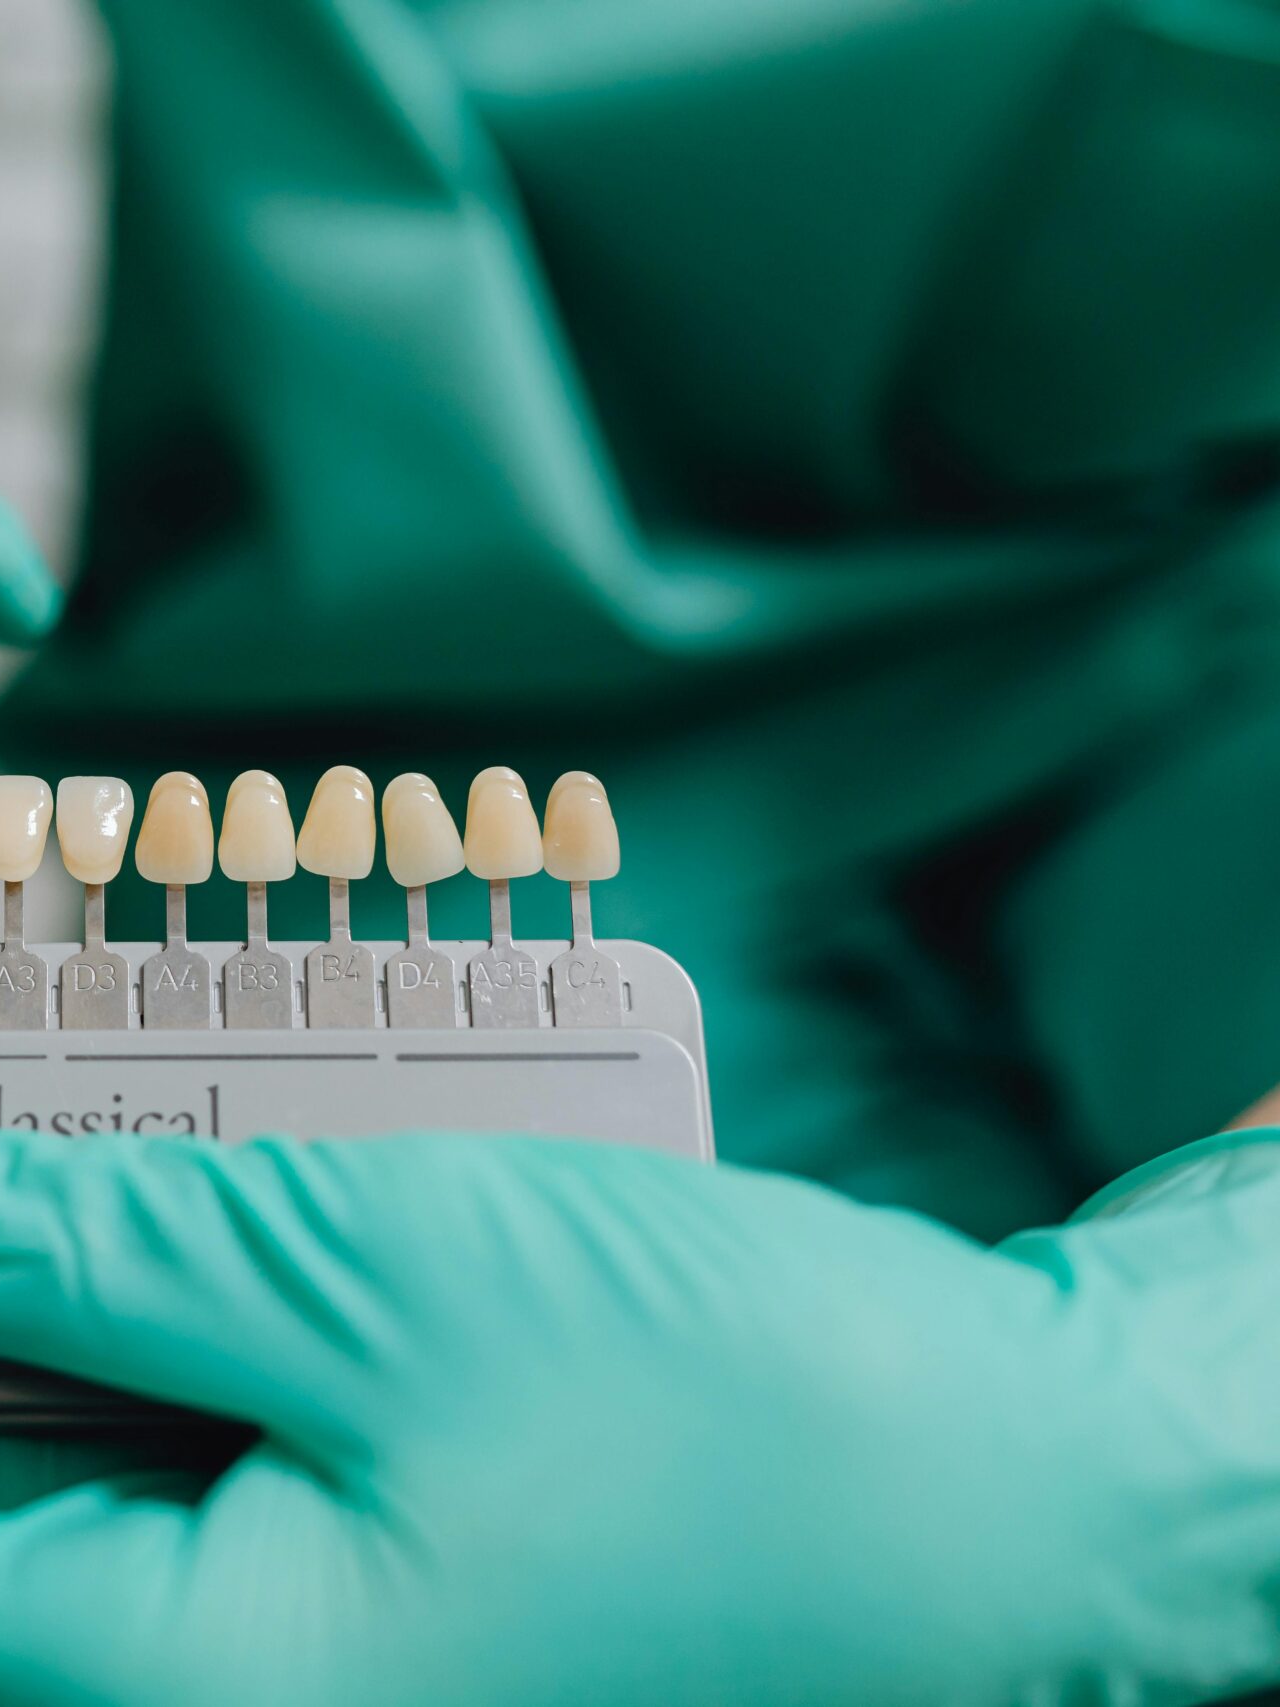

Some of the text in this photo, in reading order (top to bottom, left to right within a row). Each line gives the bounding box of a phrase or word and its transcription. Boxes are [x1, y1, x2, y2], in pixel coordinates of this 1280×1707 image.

[72, 963, 116, 992] D3
[153, 963, 199, 992] A4
[237, 963, 279, 991] B3
[319, 954, 360, 983] B4
[398, 961, 441, 989] D4
[565, 960, 606, 989] C4
